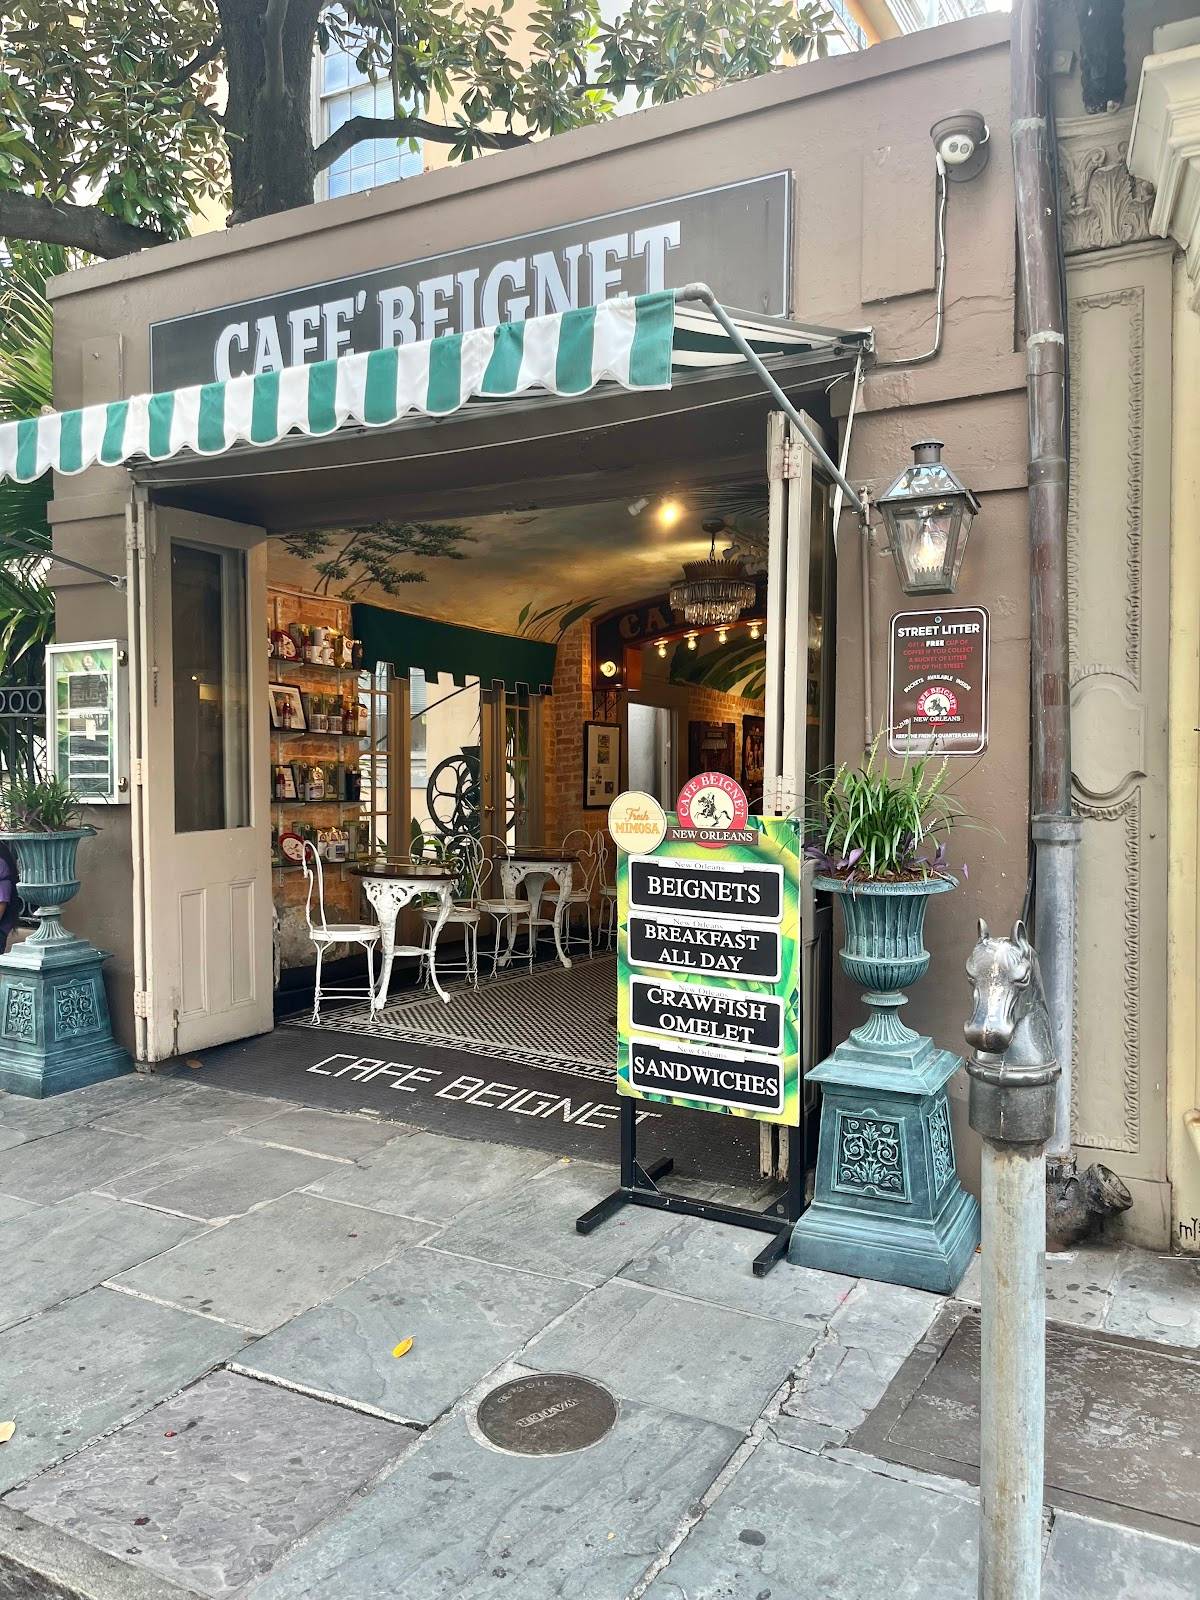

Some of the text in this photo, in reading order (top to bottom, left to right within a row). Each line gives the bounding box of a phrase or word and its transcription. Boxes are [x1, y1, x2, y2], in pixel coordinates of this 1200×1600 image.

[377, 220, 681, 349] BEIGNET
[898, 624, 980, 638] STREET LITTER
[918, 687, 957, 710] CAFE BEIGNET
[680, 774, 745, 818] CAFE BEIGNET
[623, 806, 650, 822] Fresh
[615, 822, 660, 835] MIMOSA
[672, 829, 753, 842] NEW ORLEANS
[694, 862, 725, 871] Orleans
[647, 876, 761, 904] BEIGNETS
[674, 918, 724, 930] New Orleans
[644, 924, 760, 950] BREAKFAST
[658, 948, 743, 972] ALL DAY
[678, 984, 729, 998] New Orleans
[646, 988, 767, 1022] CRAWFISH
[659, 1014, 754, 1044] OMELET
[677, 1045, 728, 1059] New Orleans
[634, 1056, 778, 1097] SANDWICHES
[306, 1053, 663, 1129] CAFE BEIGNET
[515, 1398, 580, 1428] WATER
